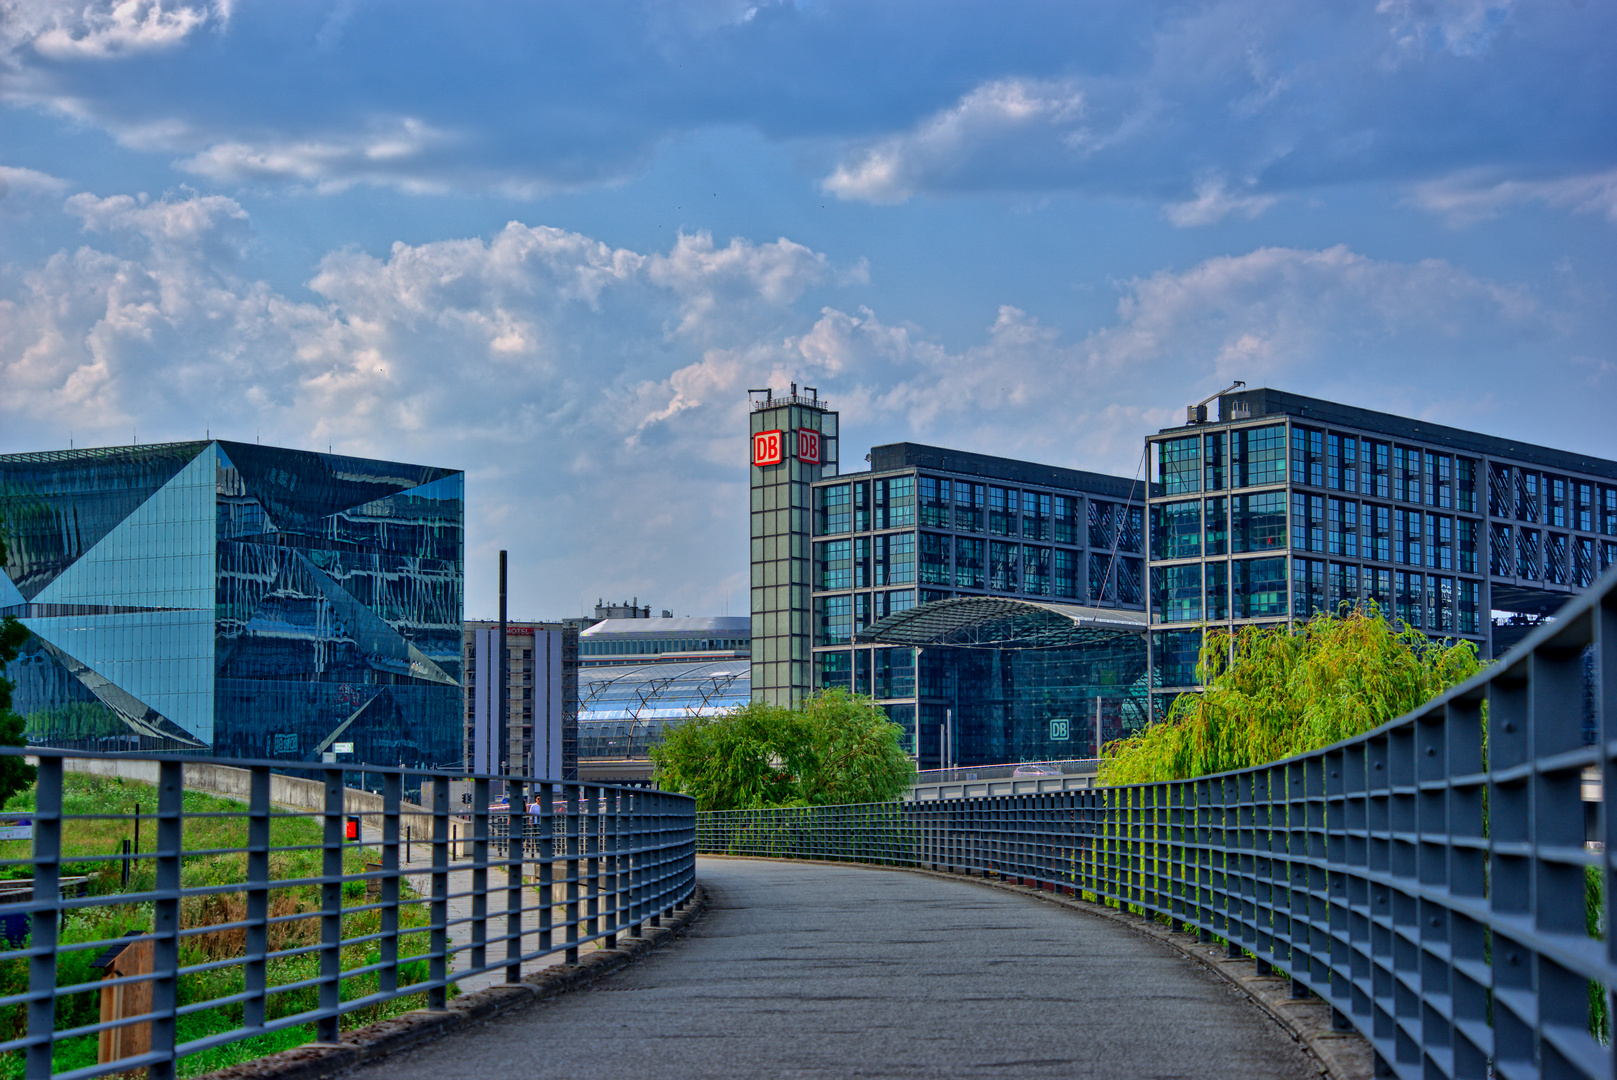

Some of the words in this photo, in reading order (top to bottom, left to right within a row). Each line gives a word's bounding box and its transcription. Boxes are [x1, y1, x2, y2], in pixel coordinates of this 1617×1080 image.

[757, 436, 778, 461] DB
[801, 433, 817, 458] DB
[1052, 722, 1067, 737] DB
